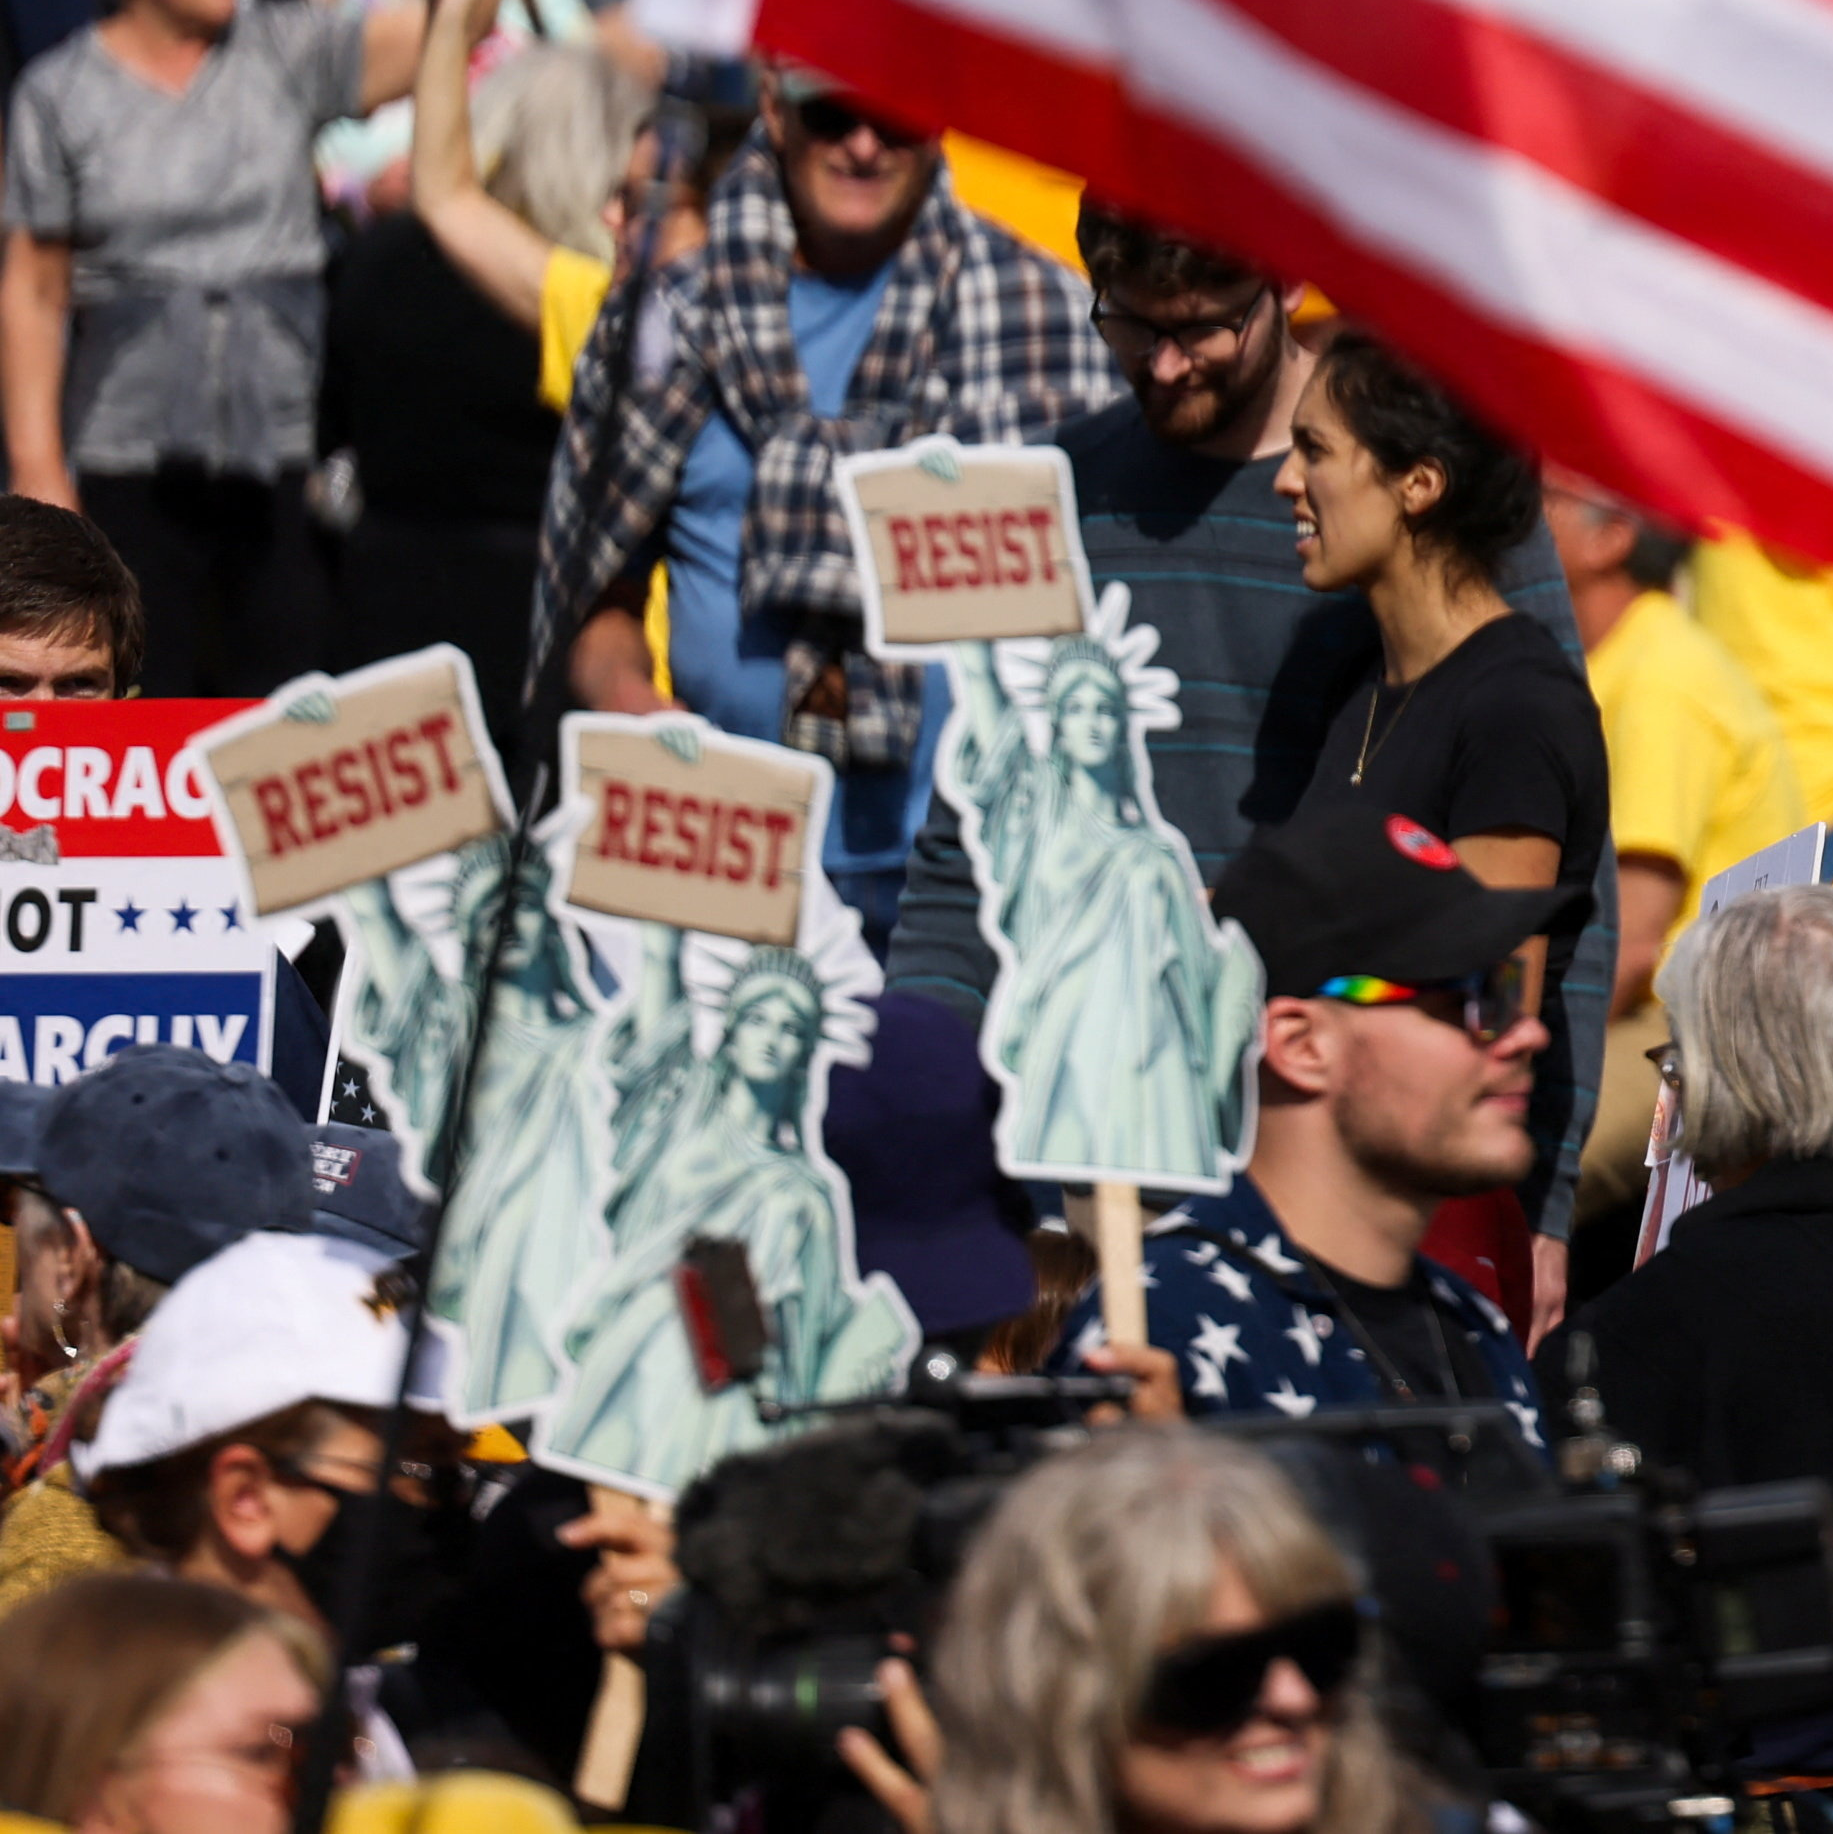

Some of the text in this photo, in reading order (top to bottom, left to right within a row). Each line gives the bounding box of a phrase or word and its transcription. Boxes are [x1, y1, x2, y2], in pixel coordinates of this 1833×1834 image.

[888, 506, 1060, 595] RESIST
[250, 712, 464, 861] RESIST
[597, 780, 797, 893] RESIST
[0, 886, 98, 954] OT
